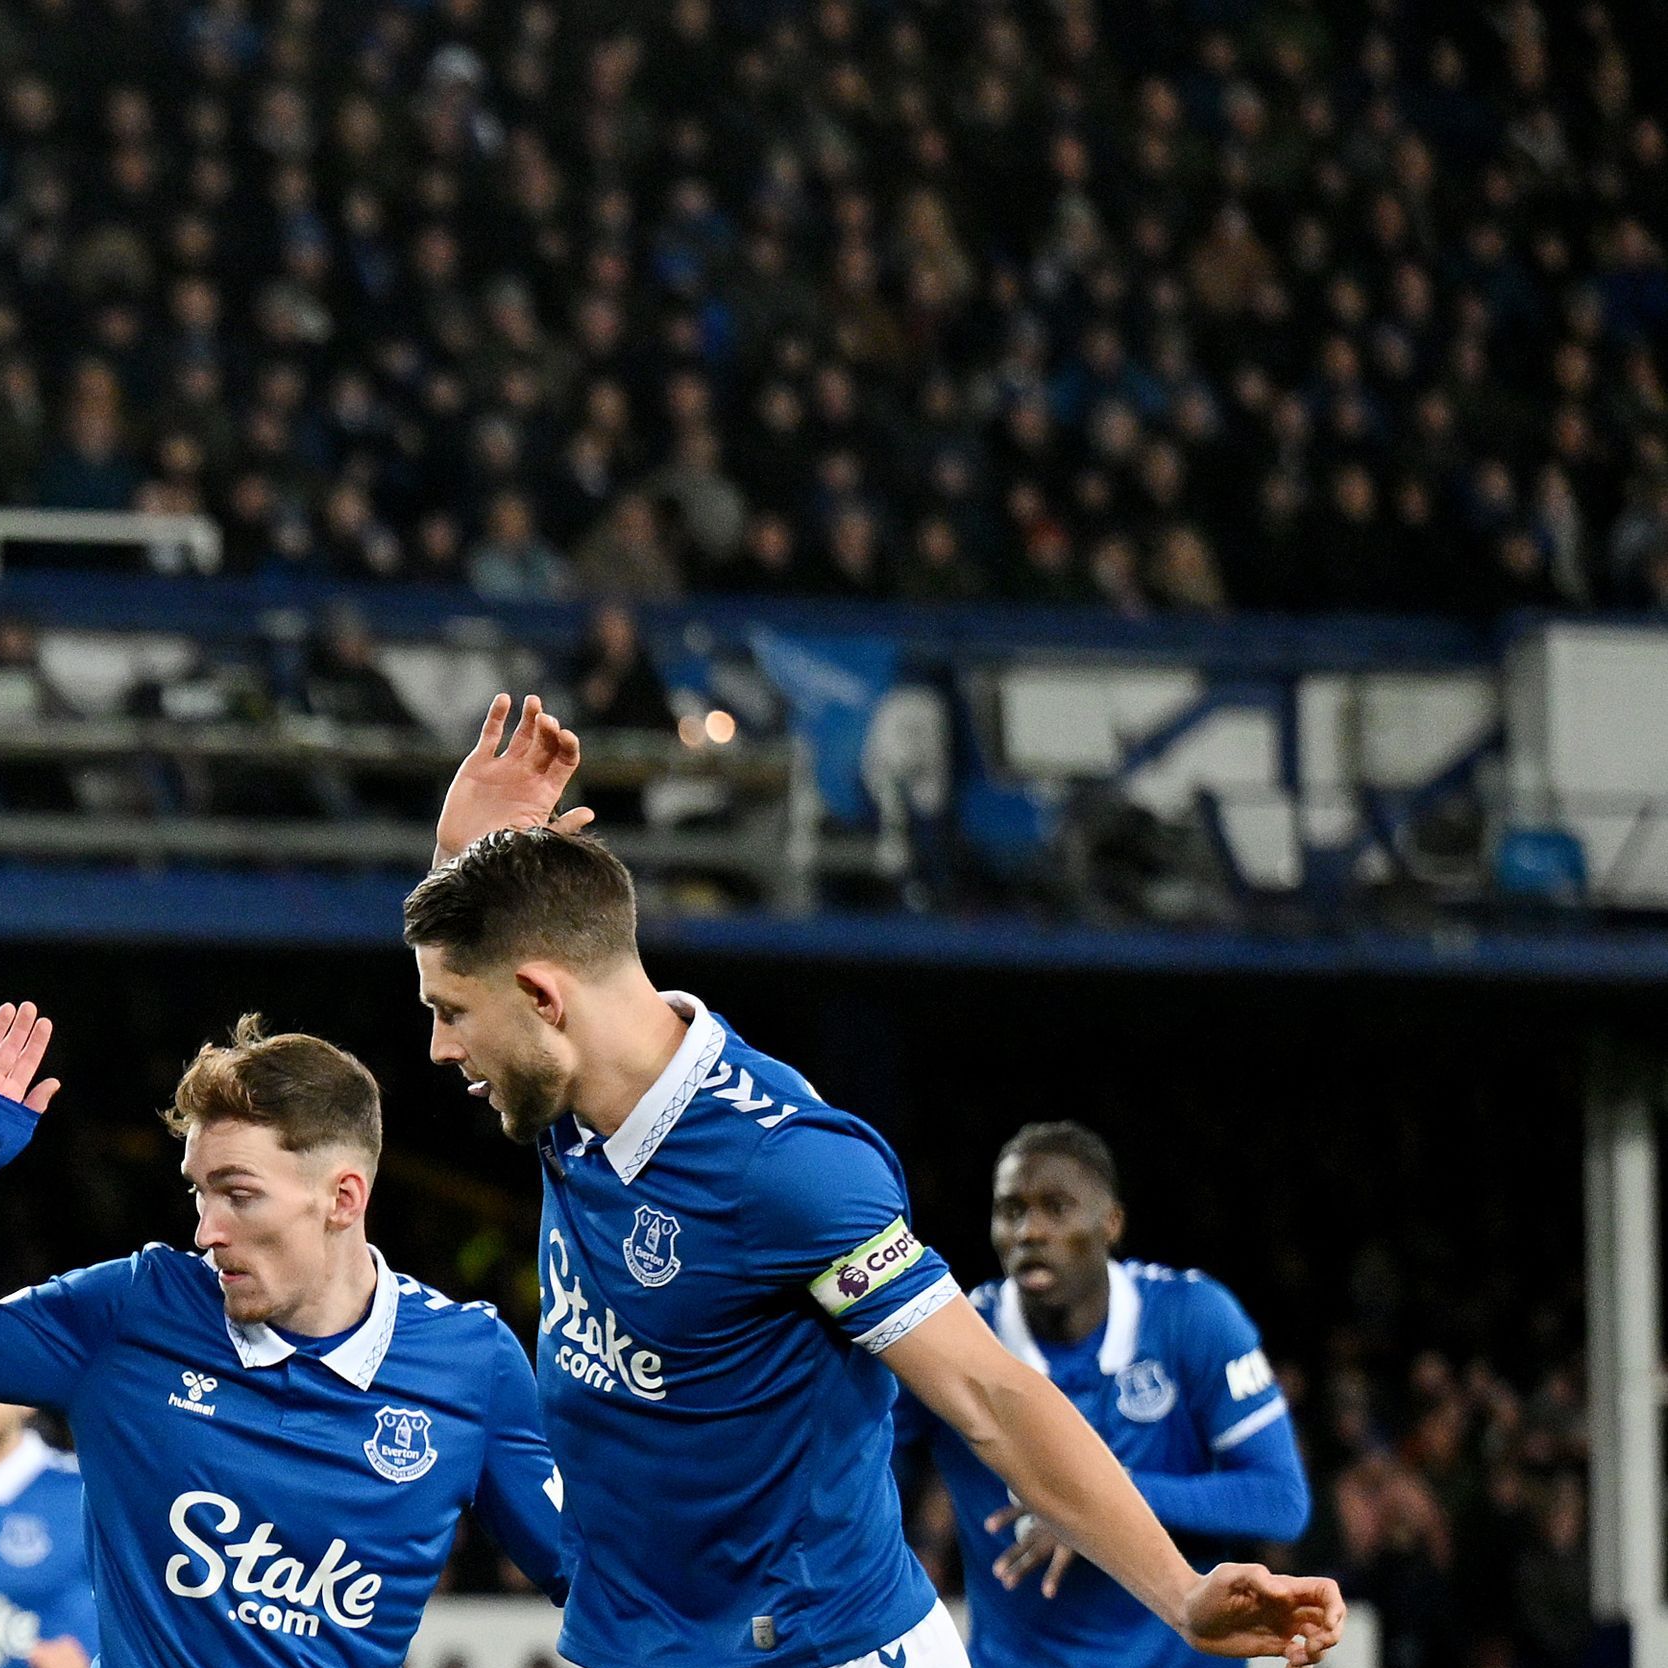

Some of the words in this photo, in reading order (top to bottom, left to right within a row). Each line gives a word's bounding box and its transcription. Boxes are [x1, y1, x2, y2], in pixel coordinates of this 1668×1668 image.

[867, 1229, 915, 1271] Capt
[540, 1228, 666, 1401] Stake
[555, 1345, 617, 1393] .com
[168, 1392, 216, 1416] hummel
[381, 1444, 420, 1460] Everton
[165, 1490, 382, 1629] Stake
[227, 1600, 320, 1637] .com
